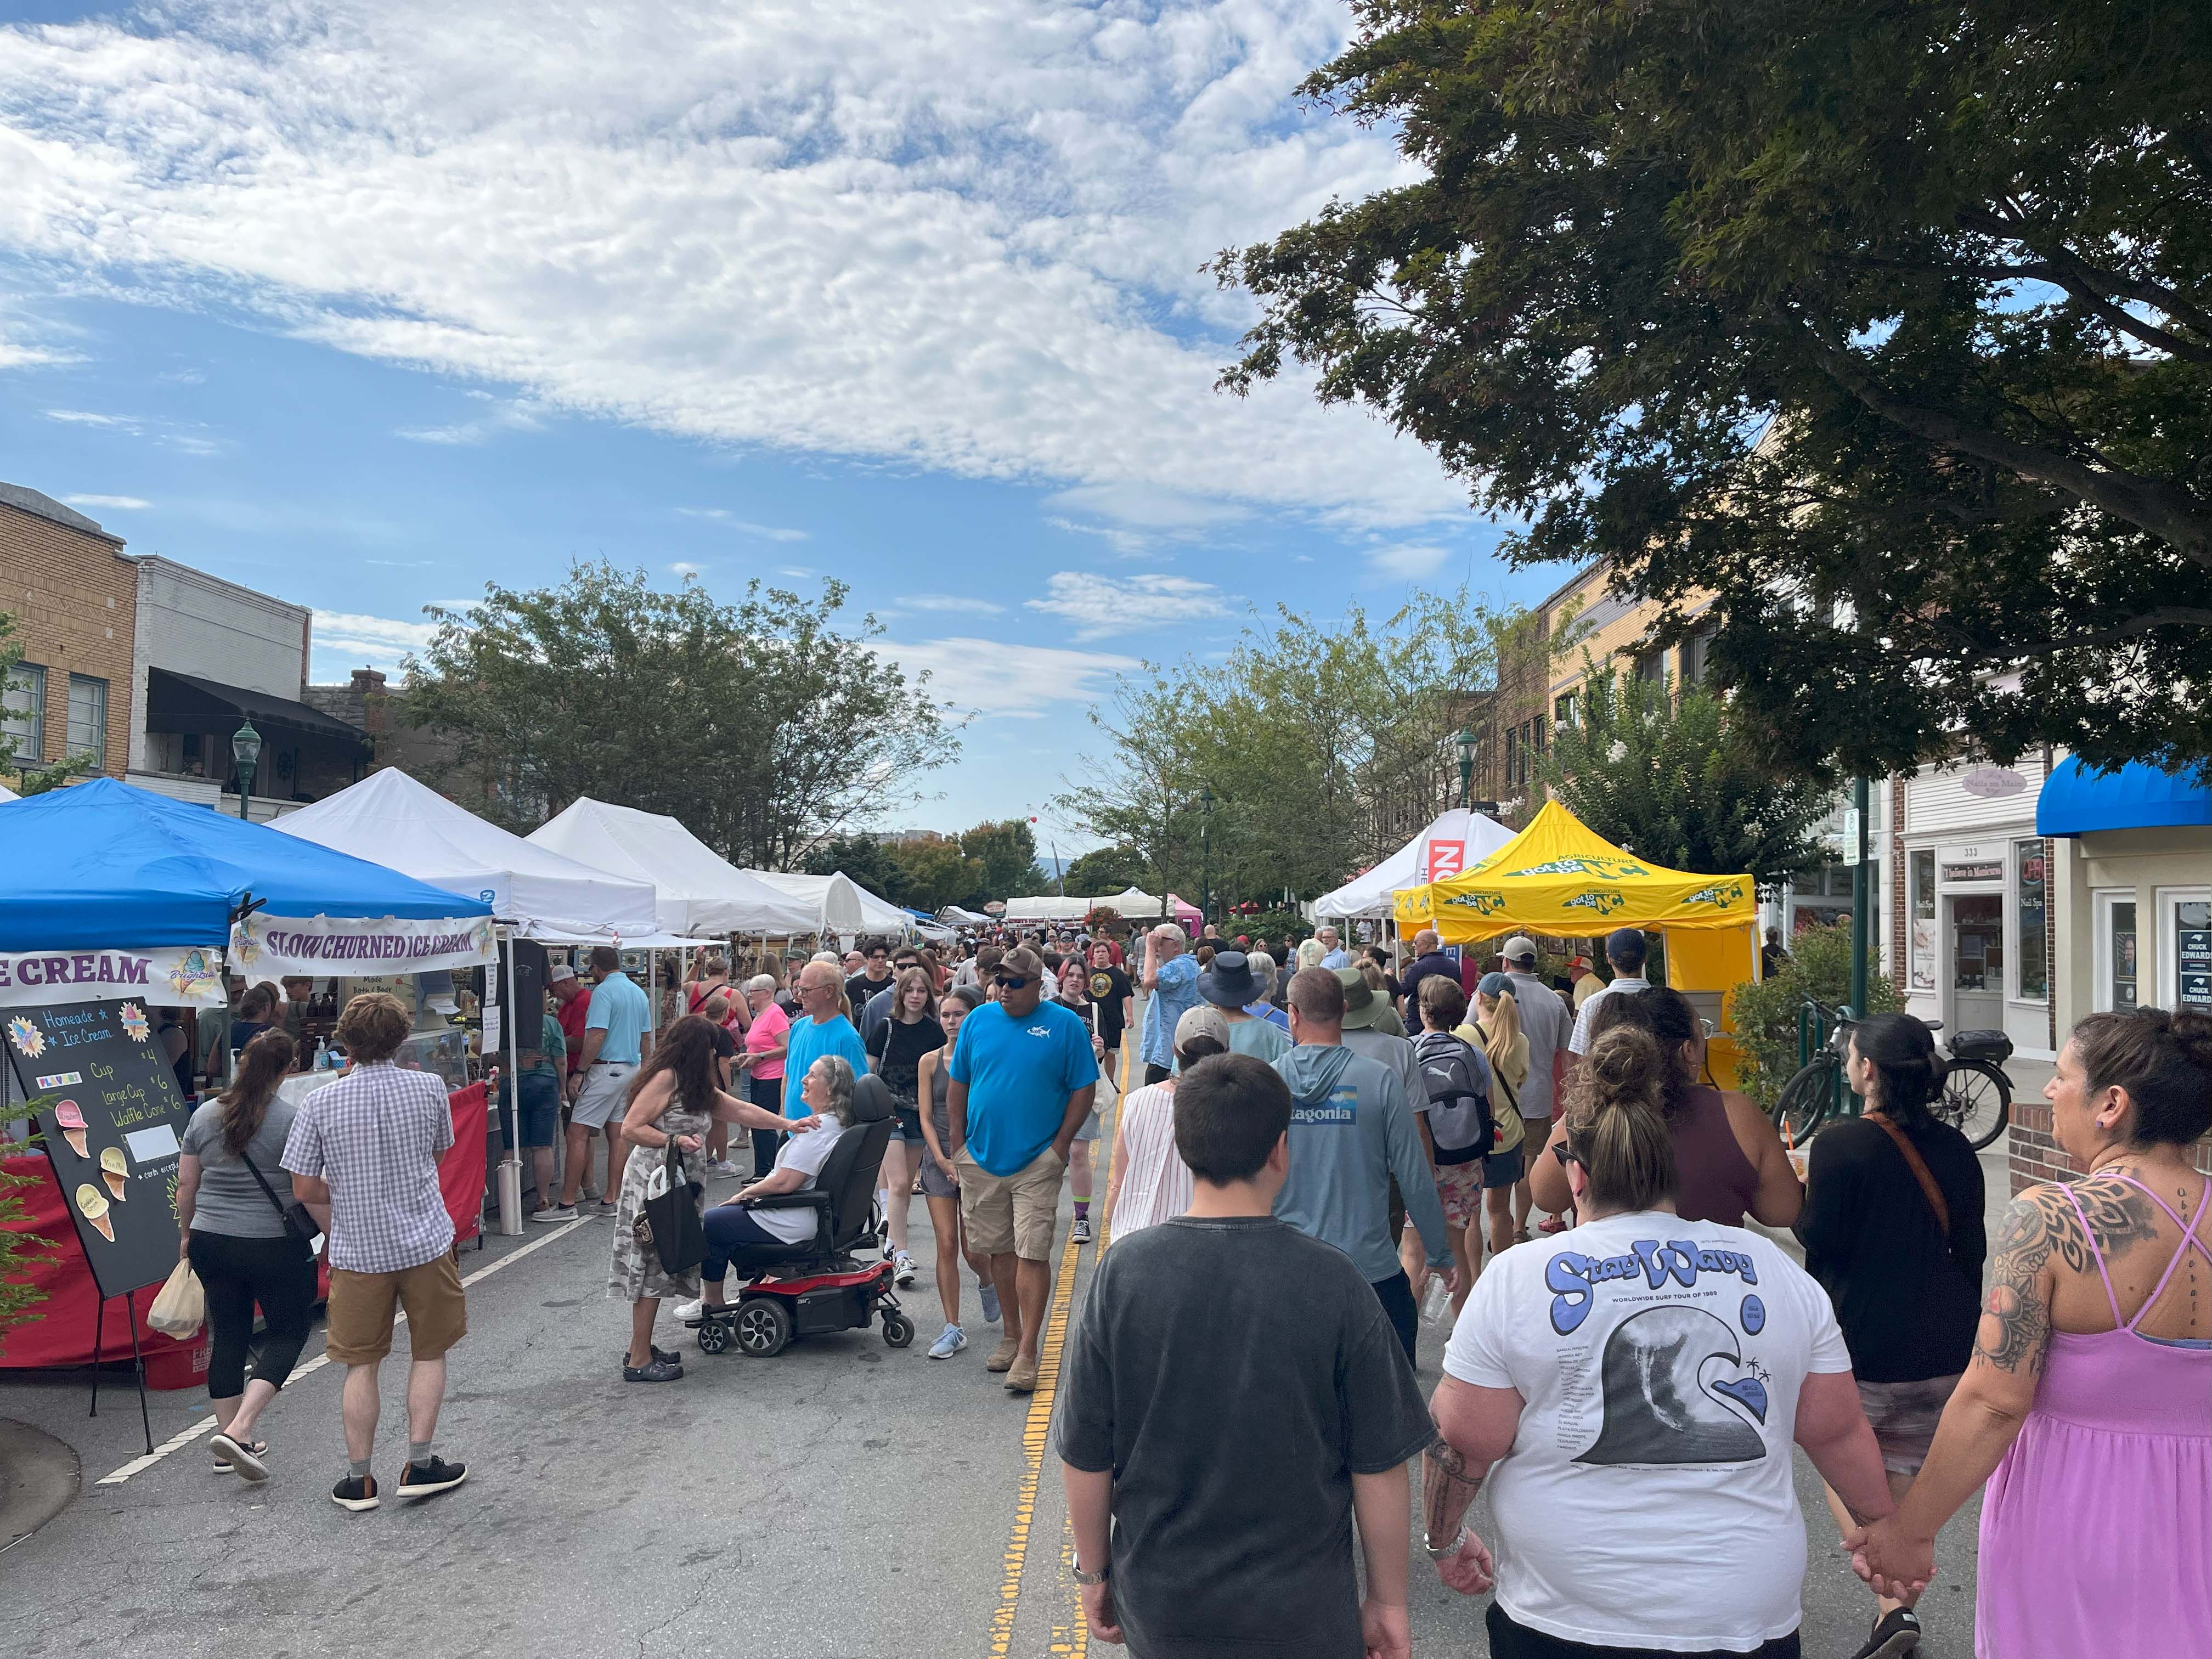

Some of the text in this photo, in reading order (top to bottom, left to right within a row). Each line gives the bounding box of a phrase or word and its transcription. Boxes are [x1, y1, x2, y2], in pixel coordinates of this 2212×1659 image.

[1558, 854, 1637, 865] AGRICULTURE
[1964, 848, 1978, 857] 333
[1520, 859, 1577, 876] got to
[1556, 861, 1643, 878] be NC
[1452, 896, 1467, 905] got
[1477, 896, 1503, 912] NC
[1570, 895, 1585, 907] got
[1596, 894, 1622, 911] NC
[1689, 893, 1703, 902] got
[1714, 886, 1739, 905] NC
[2021, 898, 2042, 910] Nail Spa
[266, 931, 323, 959] SLOW
[321, 935, 405, 959] CHURNED
[406, 935, 430, 958] ICE
[433, 933, 473, 953] CREAM
[17, 955, 153, 985] CREAM
[2182, 994, 2212, 1003] EDWARD
[43, 1009, 95, 1029] Homeade
[60, 1028, 113, 1047] Ice Cream
[90, 1062, 114, 1081] Cup
[101, 1090, 128, 1106] Large
[127, 1084, 145, 1102] Cup
[110, 1106, 144, 1128] Waffle
[143, 1102, 166, 1119] Cone
[1290, 1106, 1351, 1123] tagonia
[144, 1161, 179, 1179] cards accepte
[1544, 1240, 1758, 1335] Stay Wavy
[1612, 1295, 1654, 1304] WORLDWIDE
